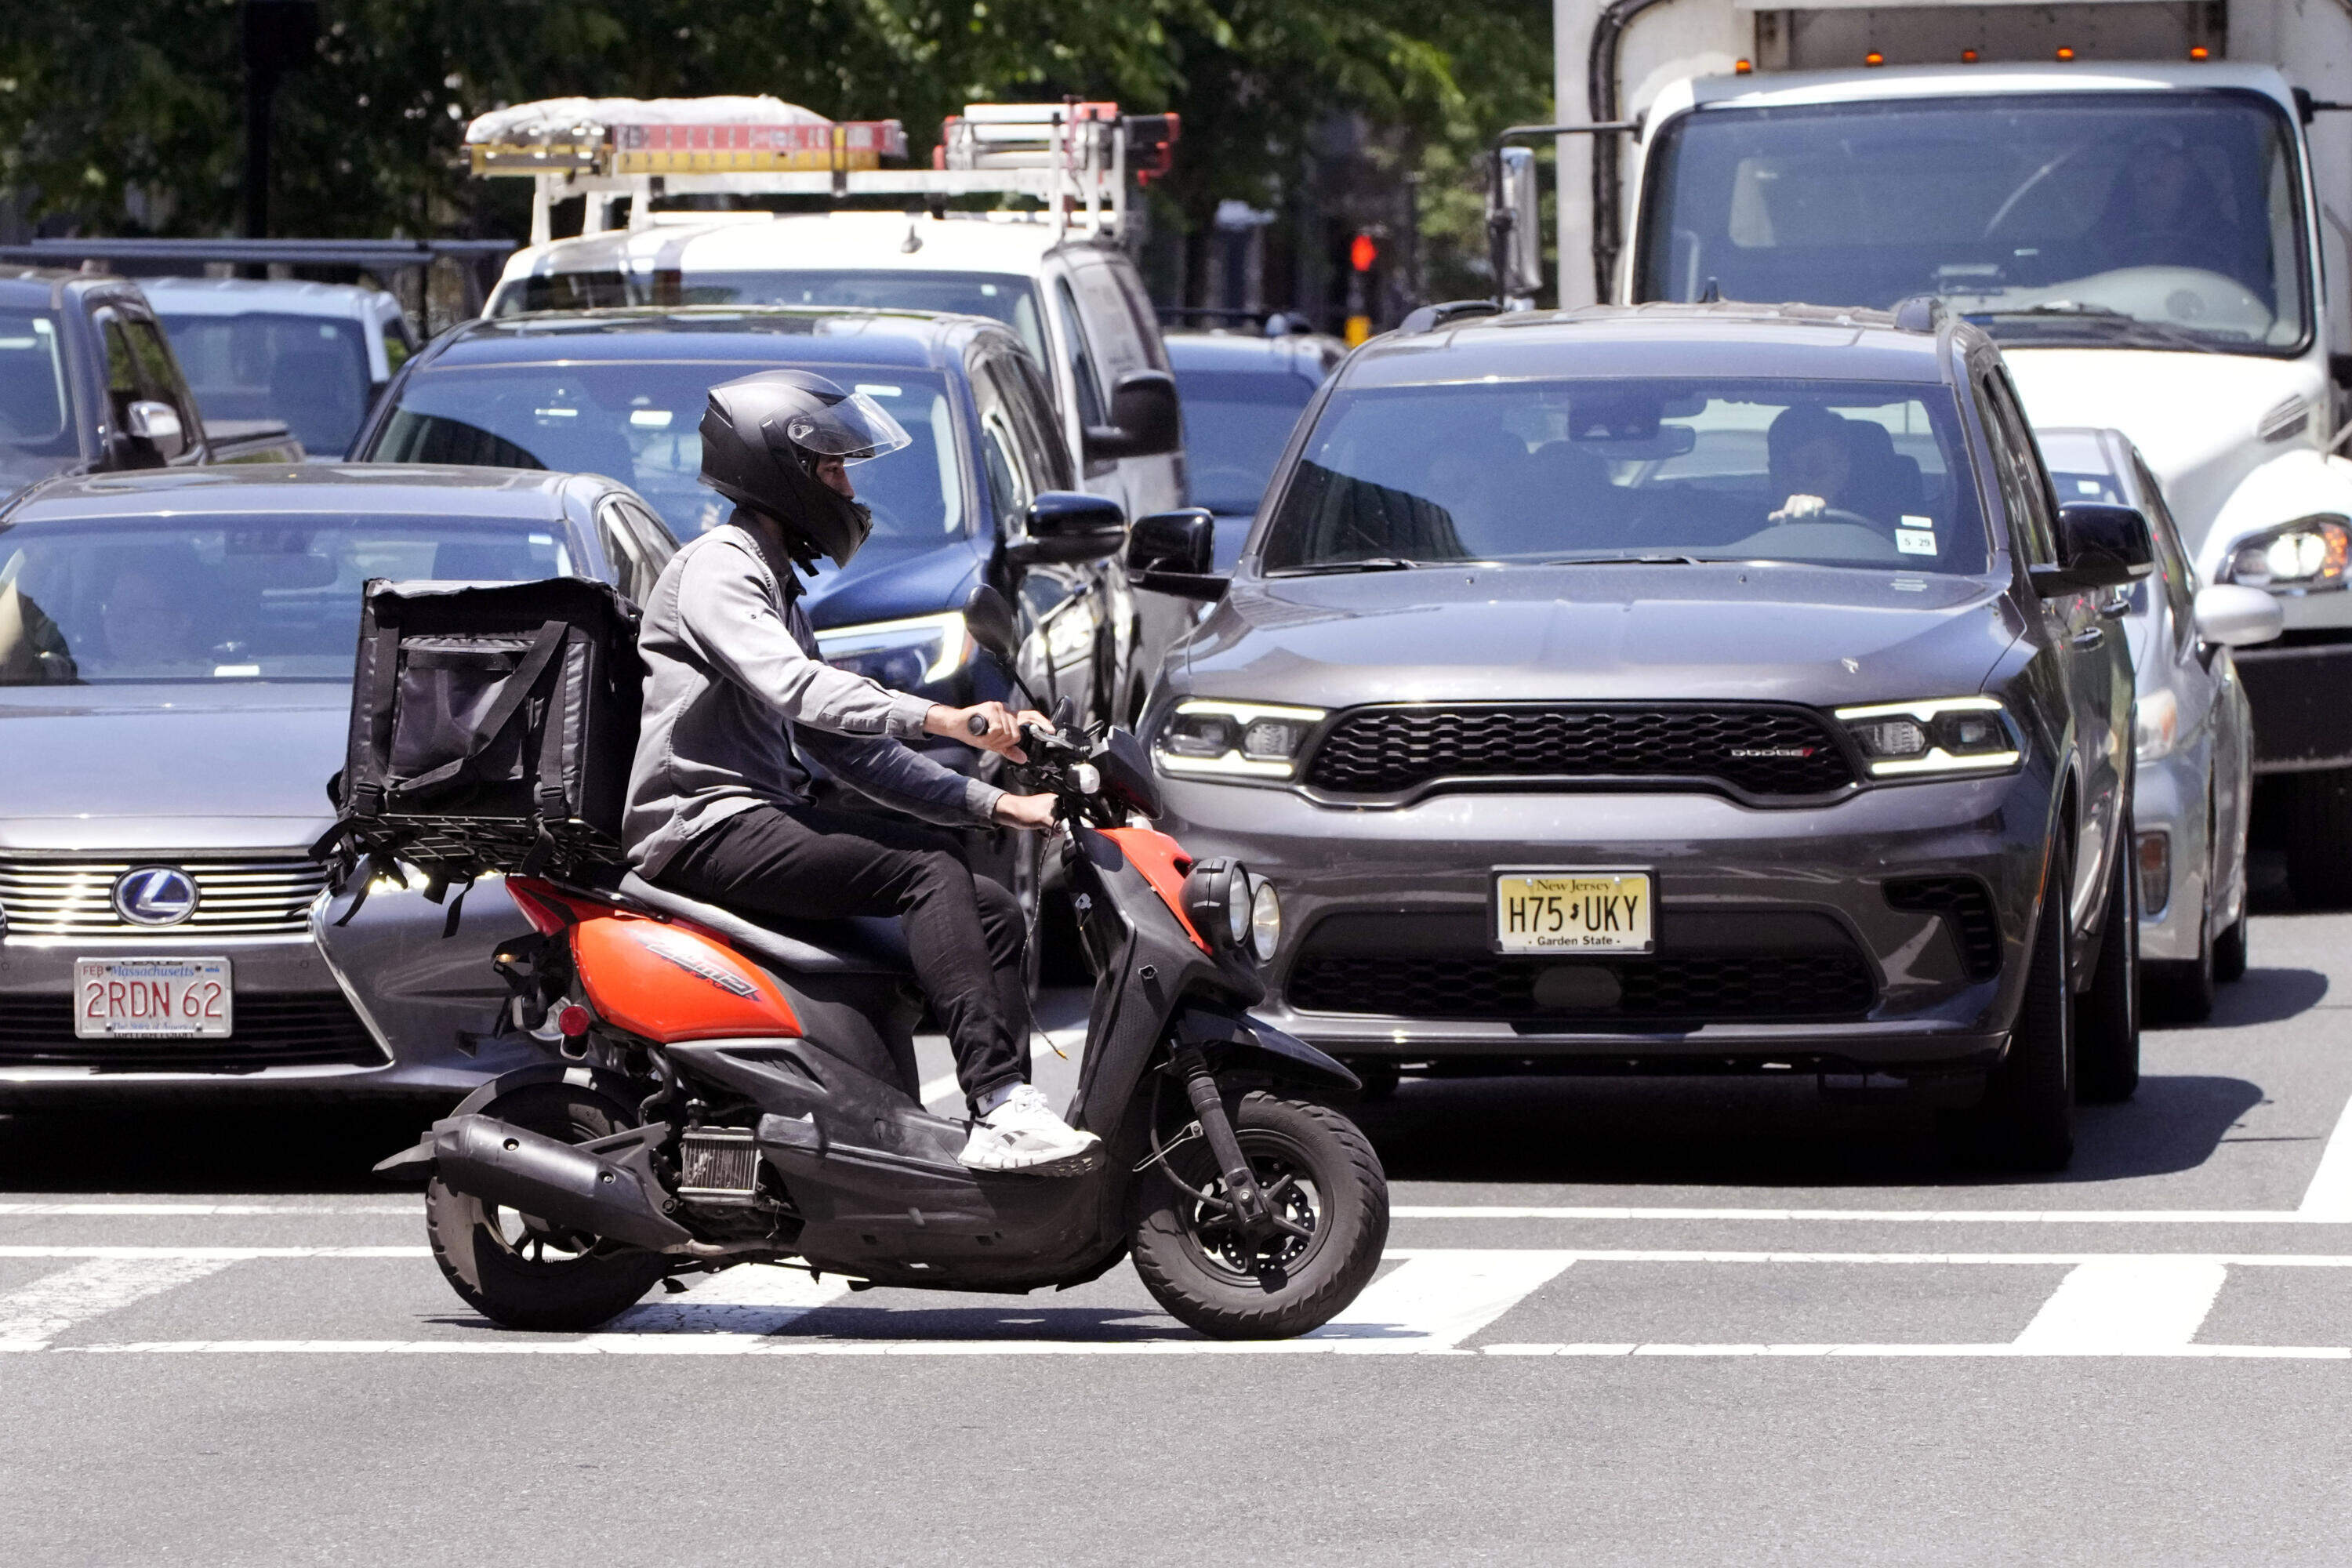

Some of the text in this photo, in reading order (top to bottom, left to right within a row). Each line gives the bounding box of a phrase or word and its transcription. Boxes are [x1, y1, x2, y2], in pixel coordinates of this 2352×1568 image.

[1537, 879, 1611, 893] New Jersey
[1509, 895, 1638, 932] H75 UKY
[1537, 936, 1613, 946] Garden State
[111, 965, 194, 977] Massachusetts
[86, 982, 222, 1018] 2RDN 62
